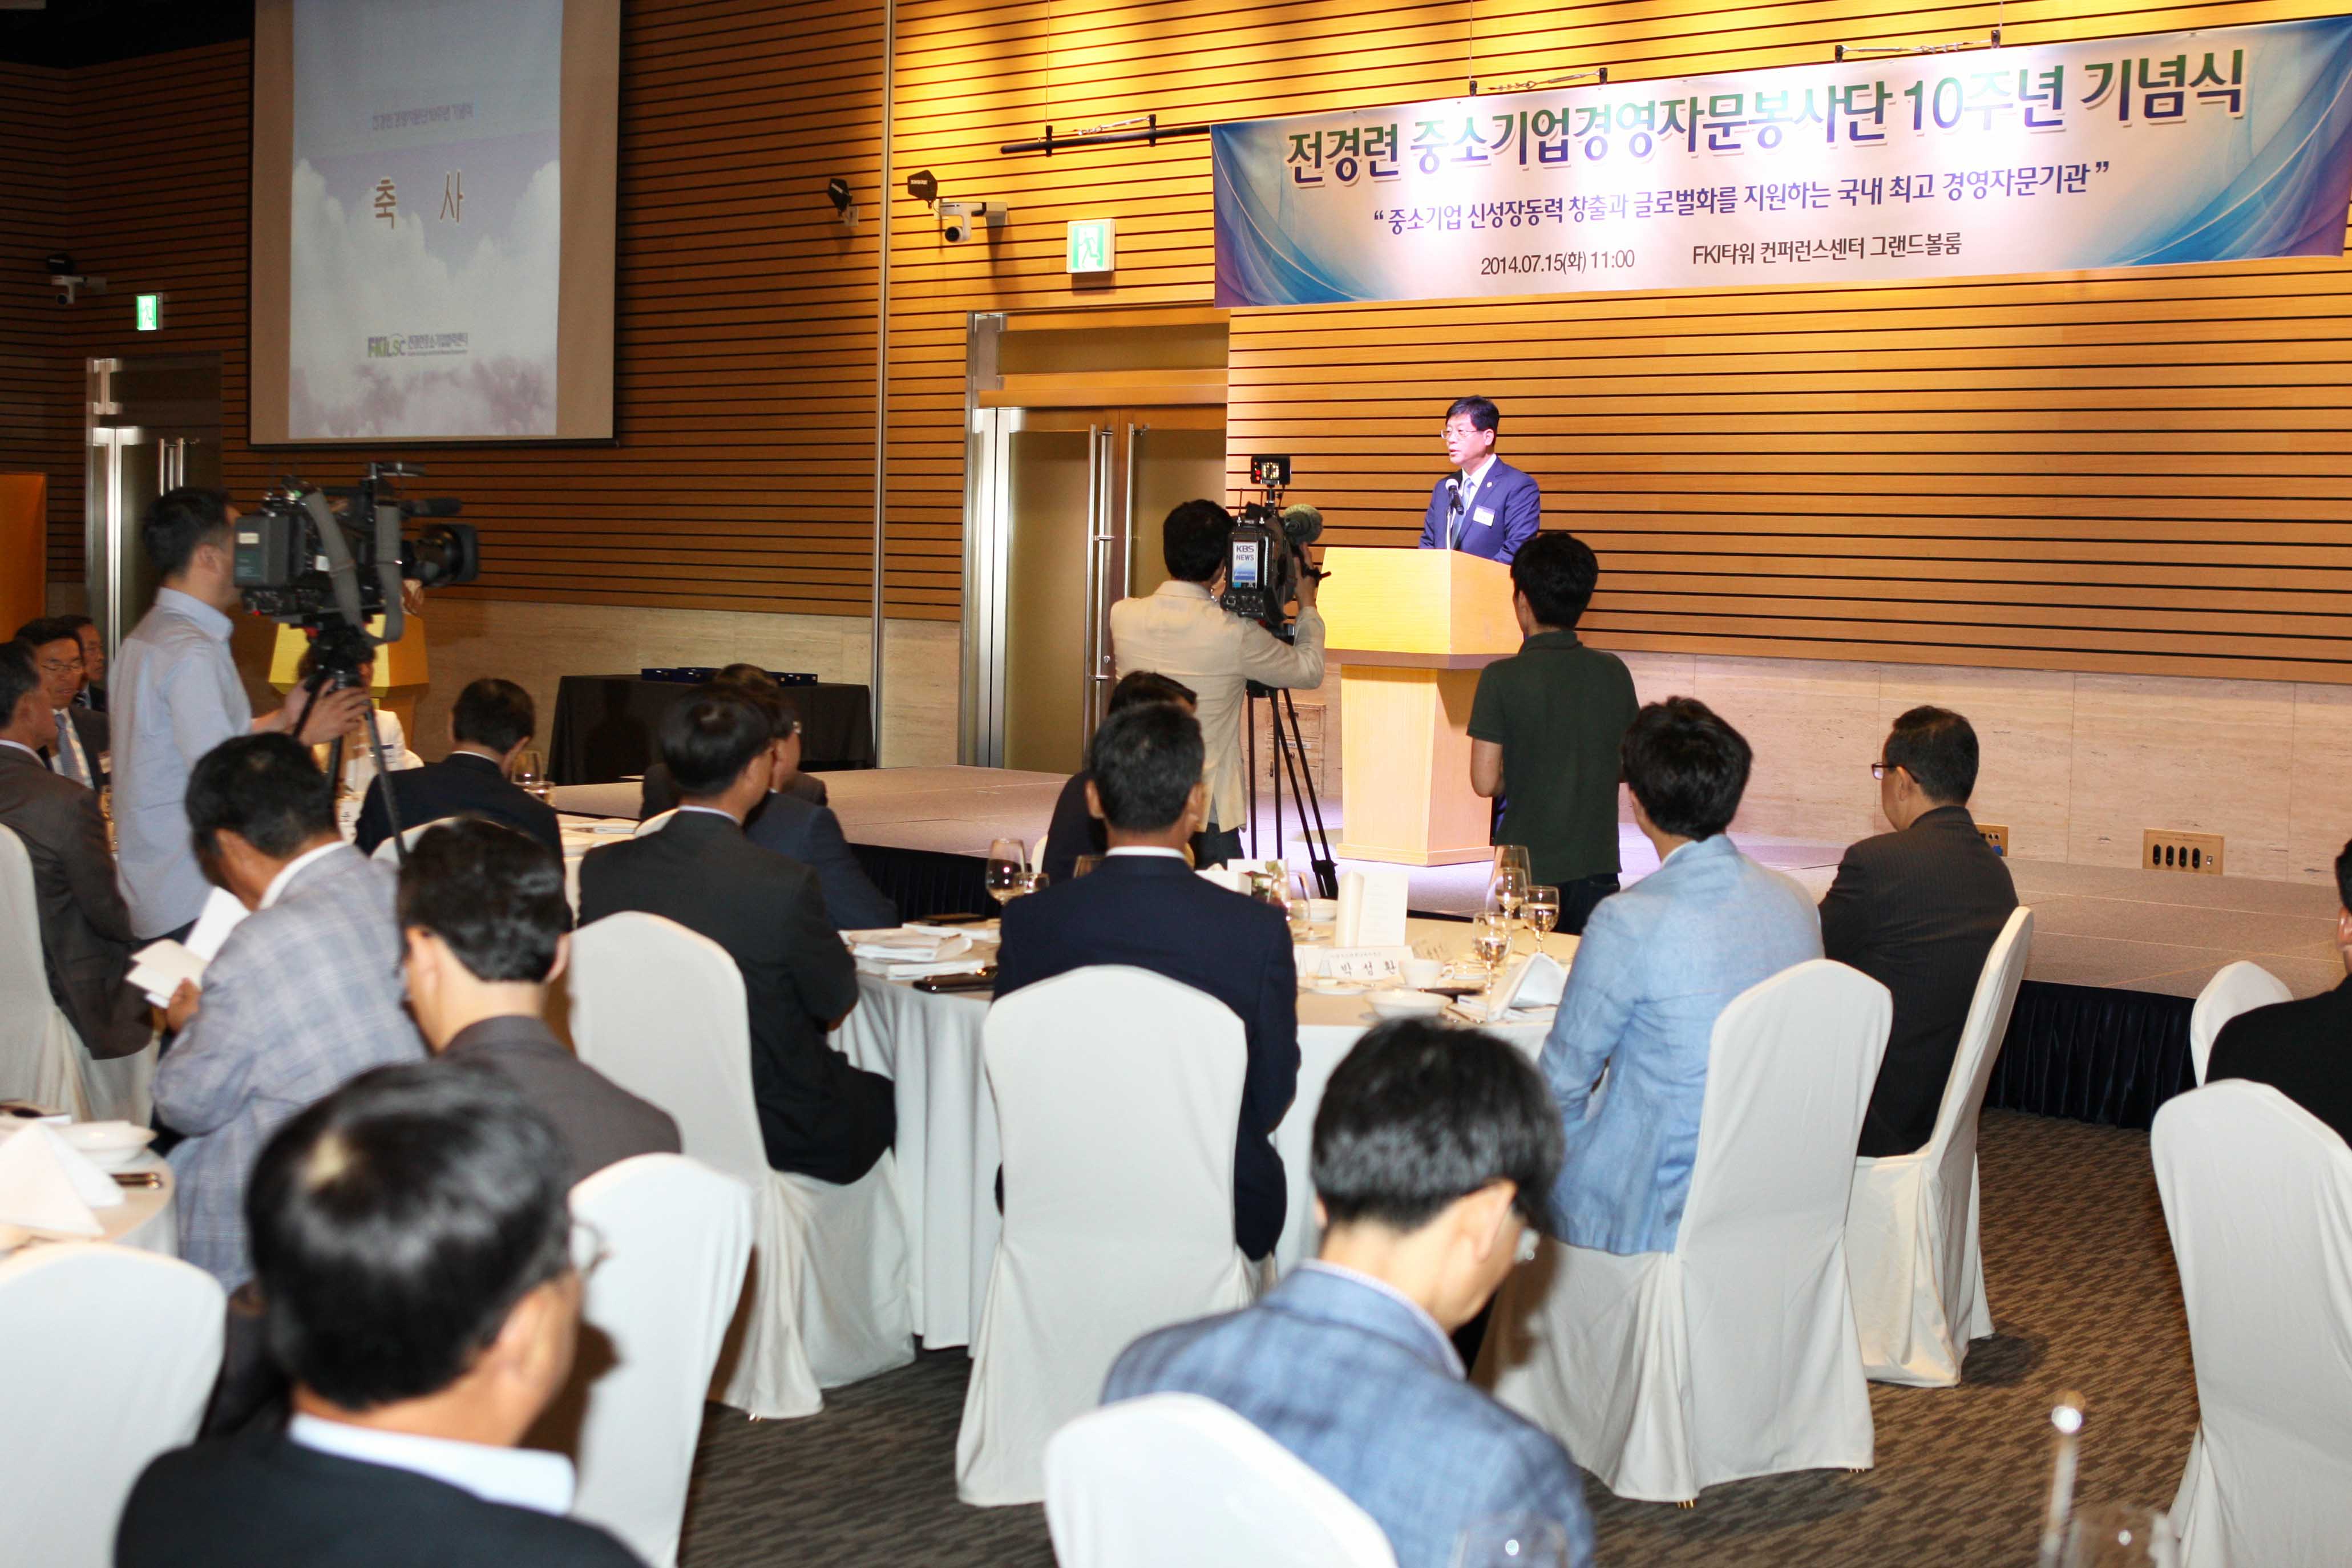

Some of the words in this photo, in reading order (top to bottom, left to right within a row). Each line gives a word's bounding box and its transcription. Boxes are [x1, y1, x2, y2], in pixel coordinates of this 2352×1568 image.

[1287, 123, 1399, 184] 전경련
[1904, 64, 2064, 131] 10주년
[2080, 49, 2245, 122] 기념식
[1468, 197, 1563, 229] 신성장동력
[1569, 193, 1628, 223] 창출과
[1634, 186, 1738, 218] 글로벌화를
[1744, 181, 1831, 212] 지원하는
[1837, 177, 1883, 206] 국내
[1889, 174, 1935, 203] 최고
[1591, 249, 1635, 268] 11:00
[1693, 243, 1755, 265] FKI타워
[1760, 237, 1865, 264] 컨퍼런스센터
[1870, 232, 1962, 258] 그랜드볼룸
